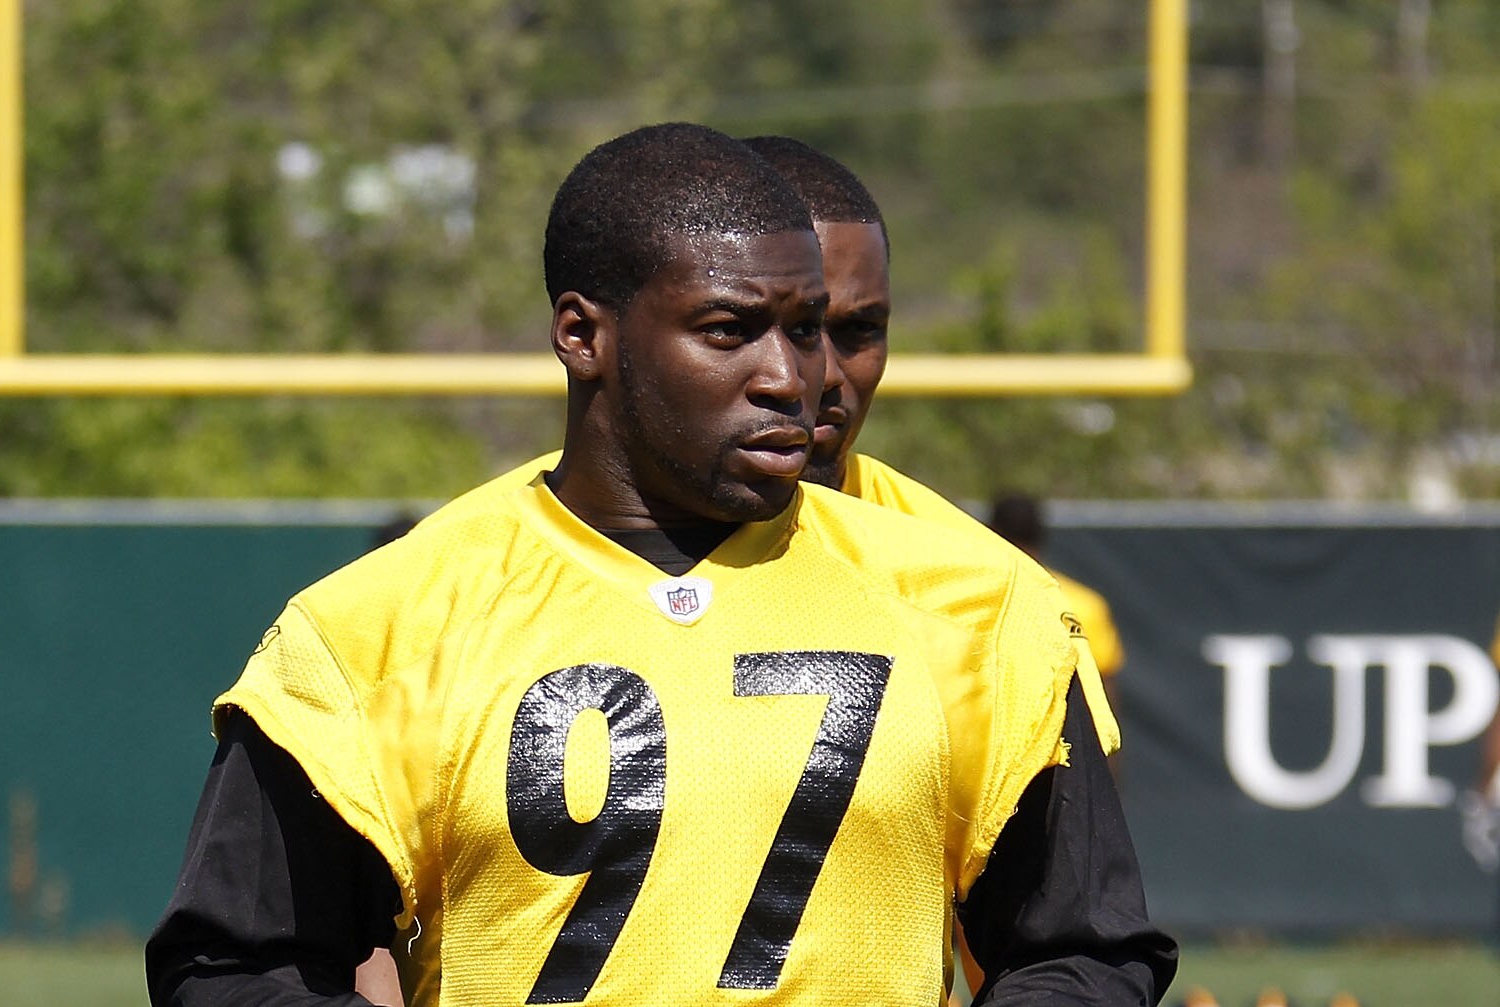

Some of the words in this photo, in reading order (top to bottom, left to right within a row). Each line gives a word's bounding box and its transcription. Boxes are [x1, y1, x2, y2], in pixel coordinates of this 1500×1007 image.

[671, 598, 697, 612] NFL
[1203, 634, 1500, 810] UP
[506, 650, 896, 1005] 97
